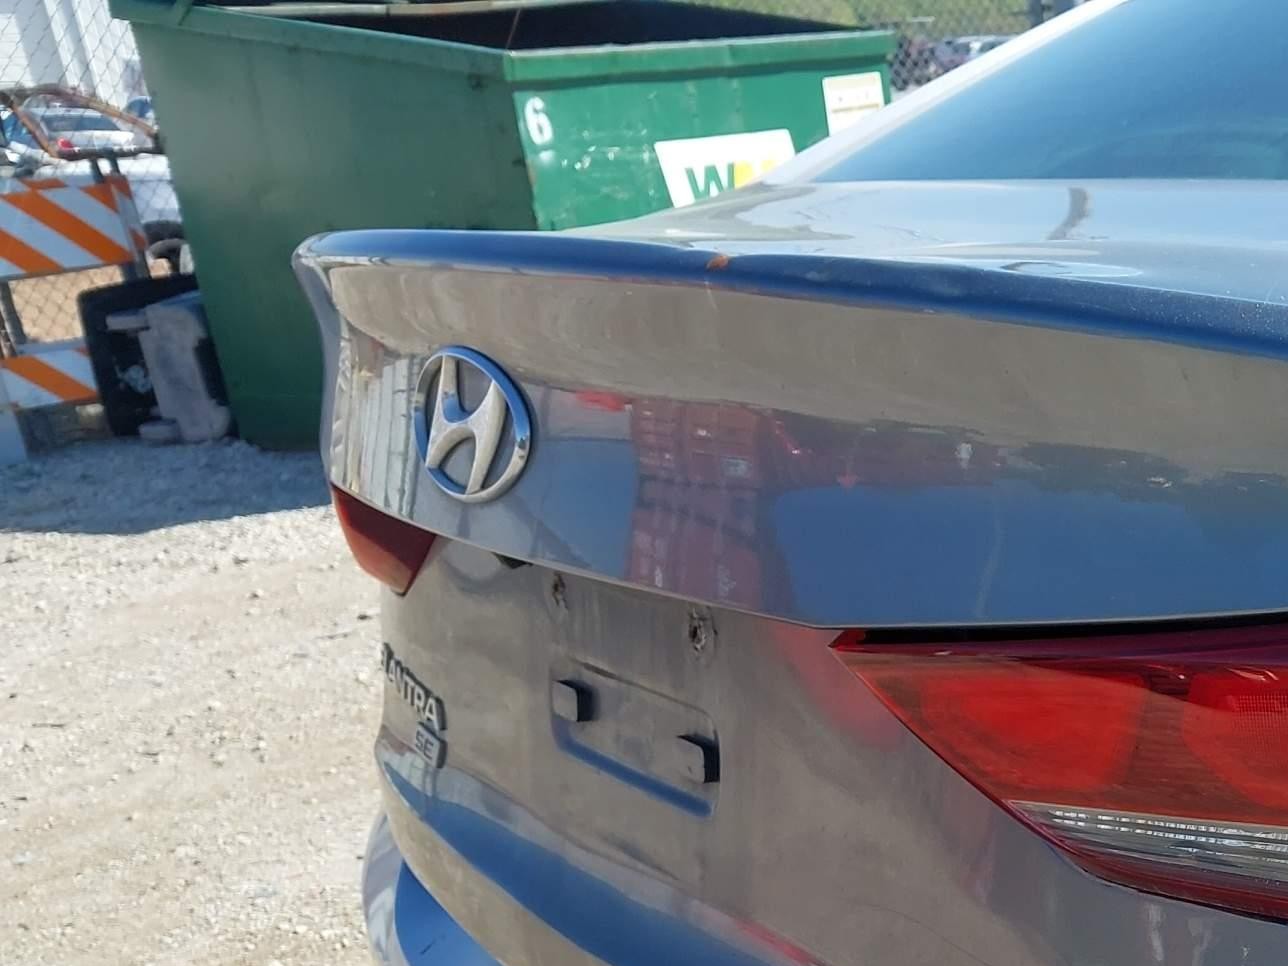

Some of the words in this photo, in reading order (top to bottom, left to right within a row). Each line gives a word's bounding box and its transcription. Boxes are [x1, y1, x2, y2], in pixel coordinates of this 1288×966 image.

[523, 95, 554, 146] 6
[381, 643, 442, 733] LANTRA
[415, 728, 436, 762] SE
